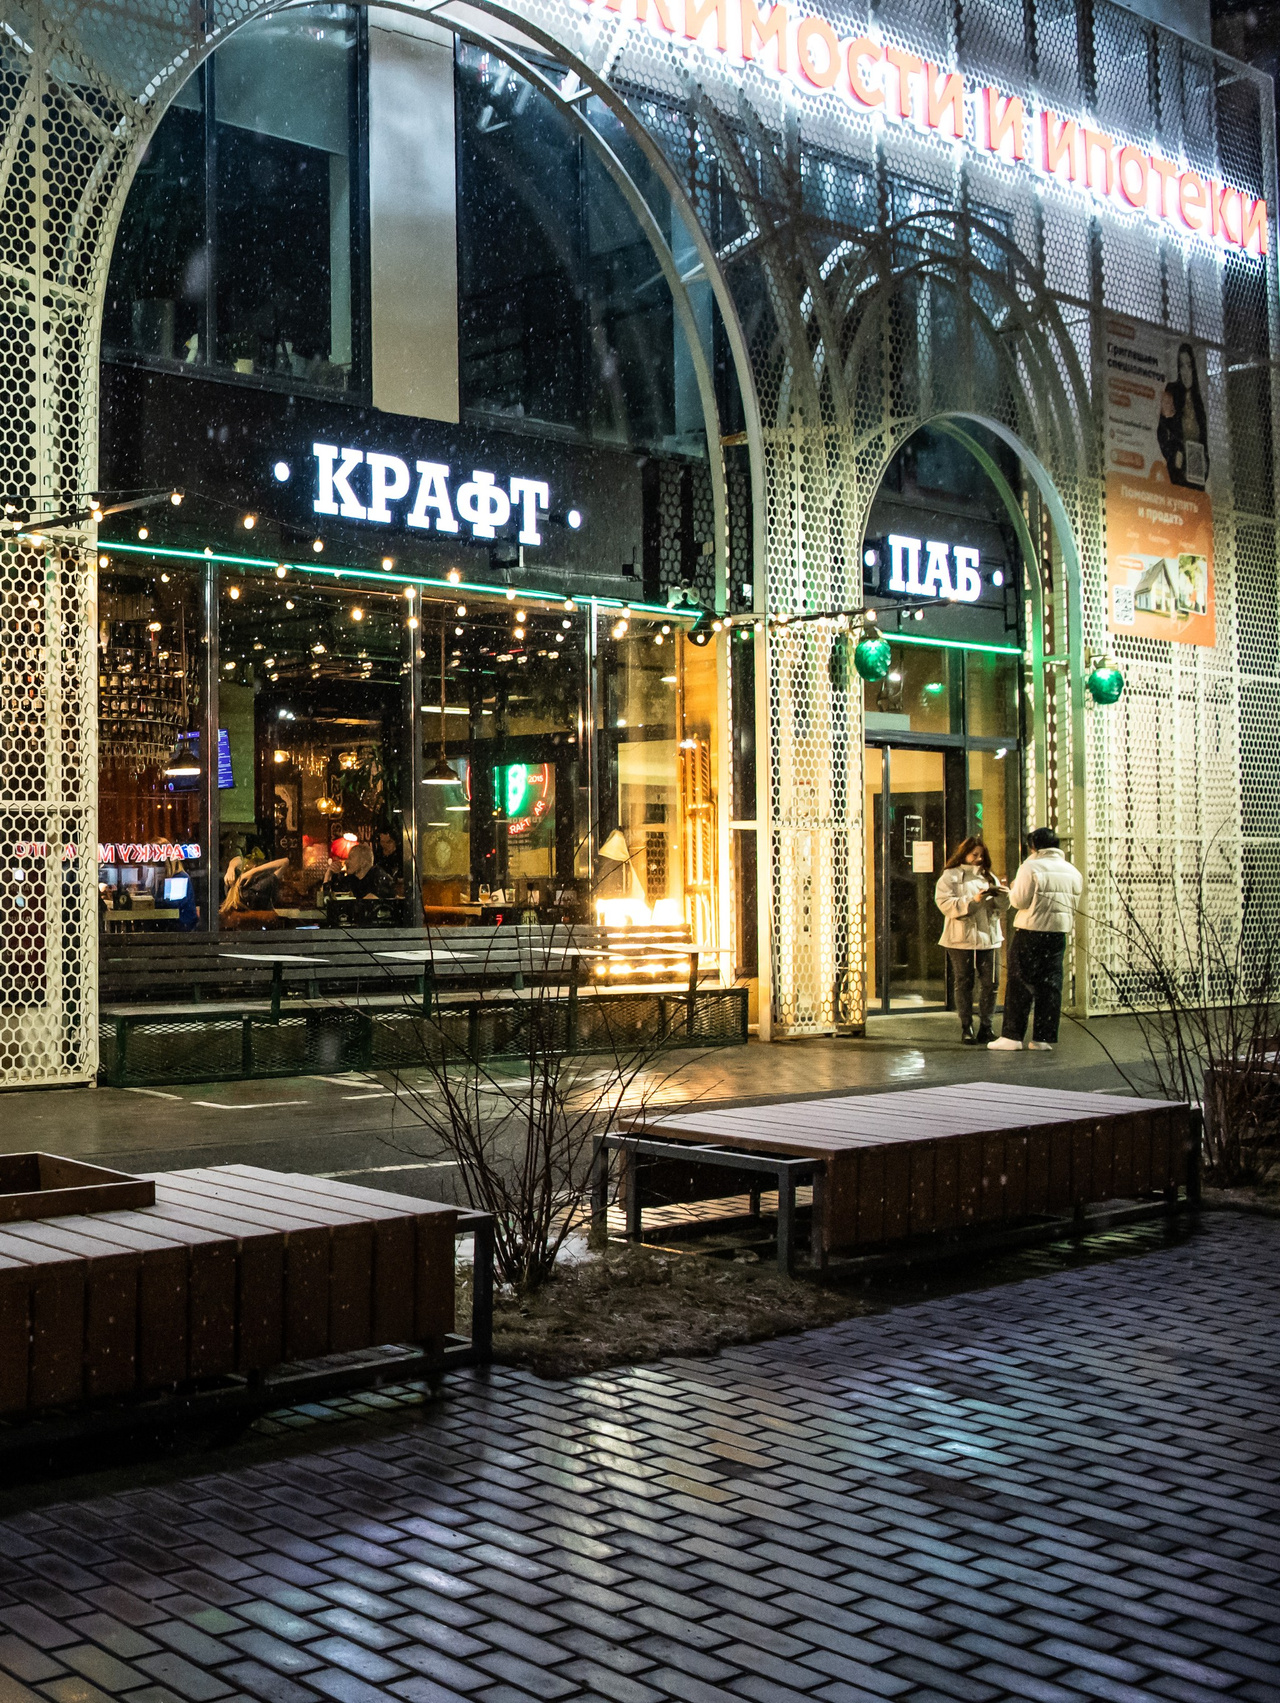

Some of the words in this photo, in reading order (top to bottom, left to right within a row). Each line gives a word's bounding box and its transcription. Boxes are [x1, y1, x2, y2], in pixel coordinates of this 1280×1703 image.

[313, 443, 549, 546] КРАФТ
[888, 534, 982, 602] ПАБ
[528, 774, 544, 784] 2015
[508, 818, 531, 835] RAFT
